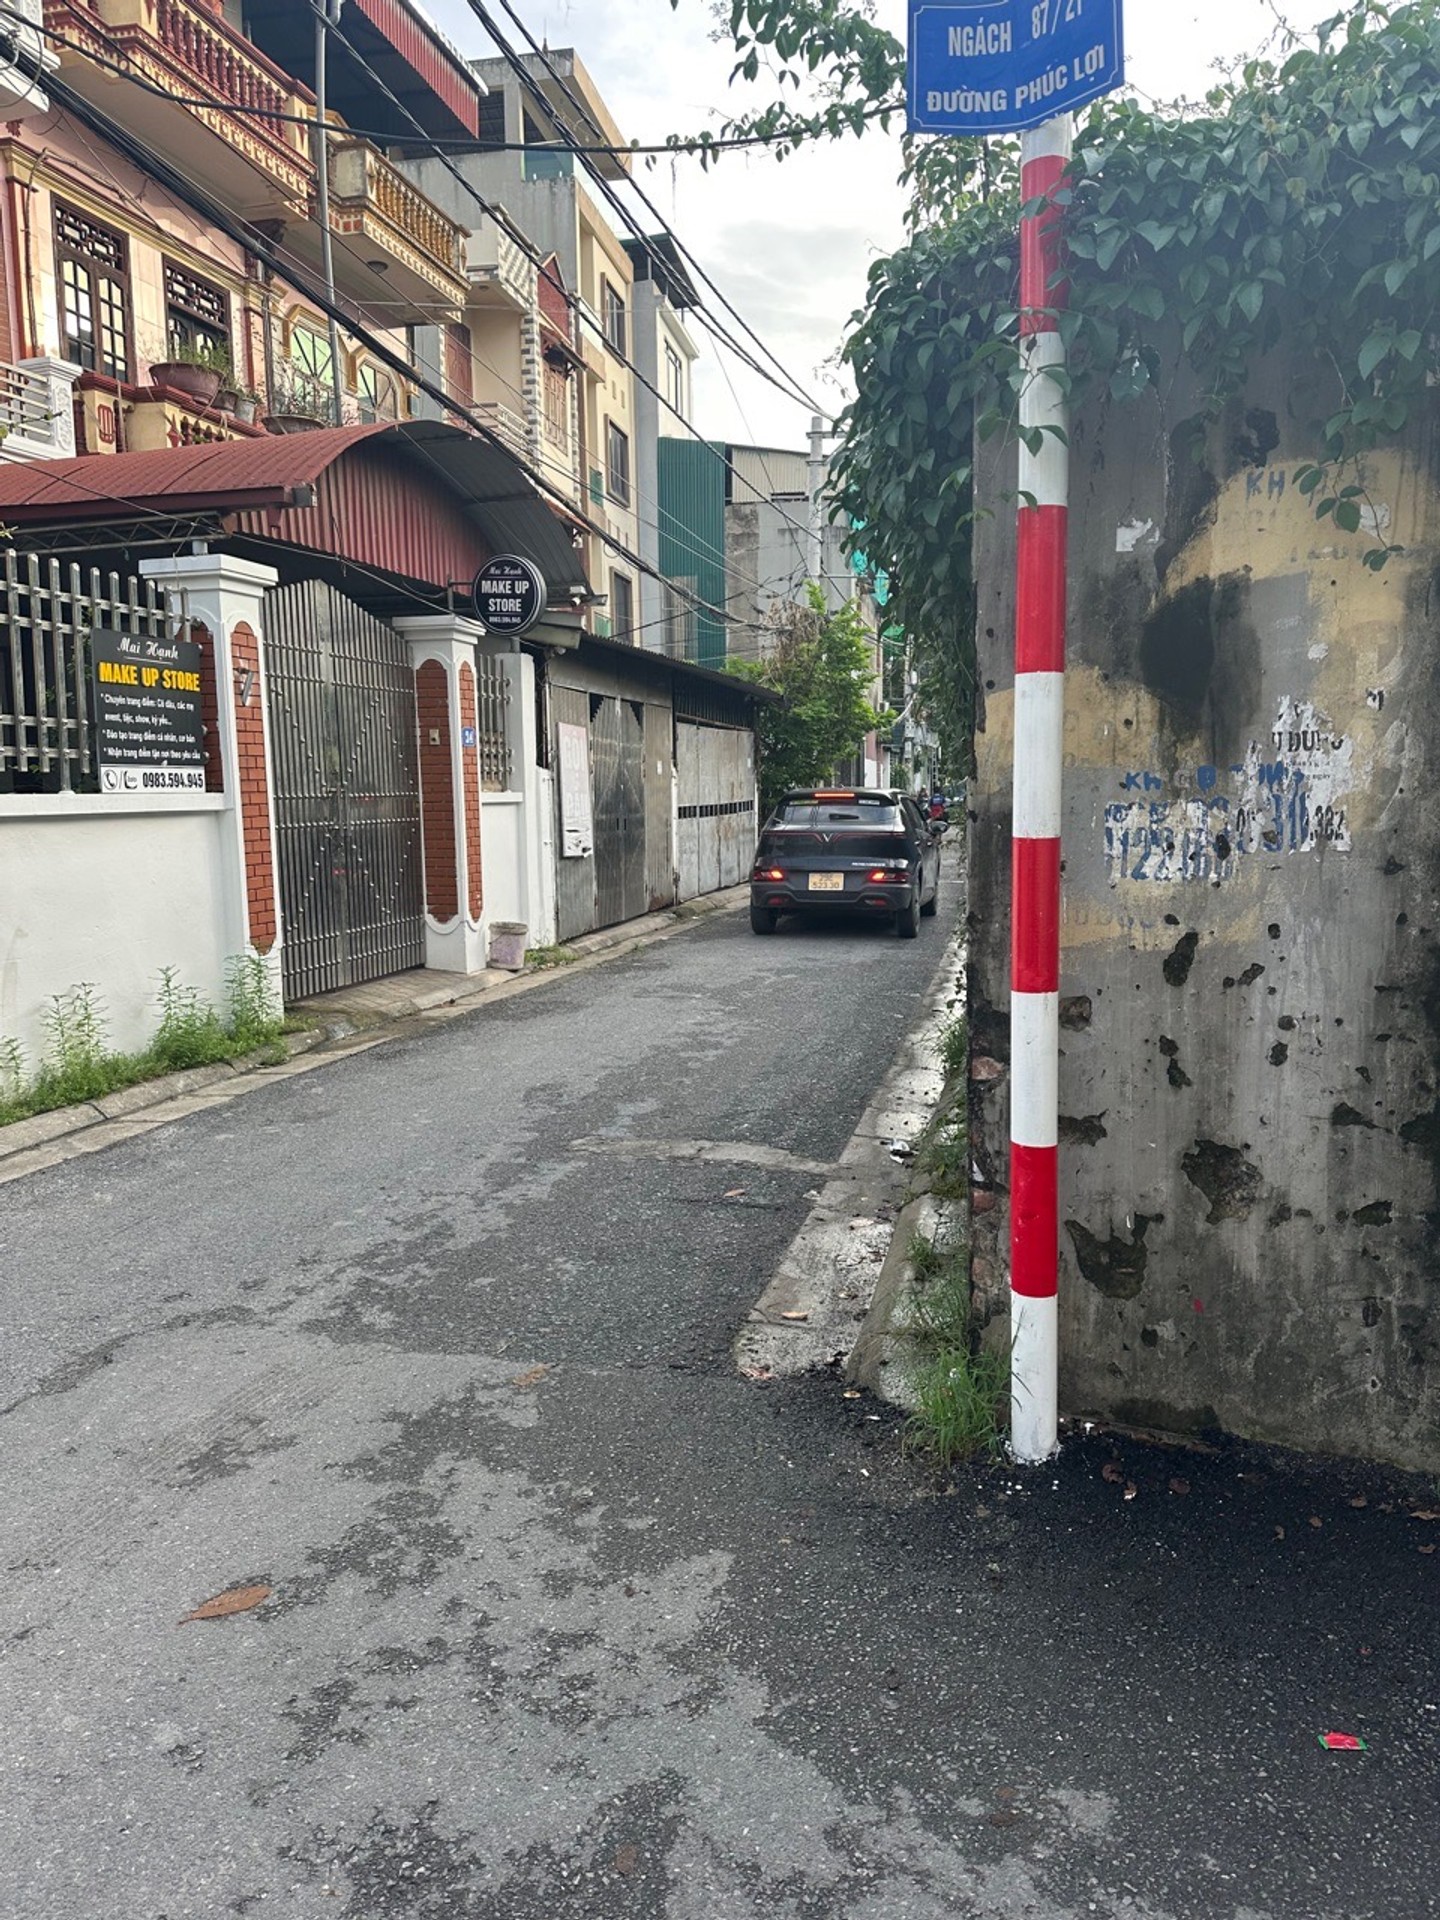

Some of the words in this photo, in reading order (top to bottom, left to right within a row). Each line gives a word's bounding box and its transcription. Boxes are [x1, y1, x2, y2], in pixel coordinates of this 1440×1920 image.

[948, 17, 1012, 57] NGÁCH
[926, 85, 1008, 113] ĐƯỜNG
[1015, 64, 1069, 110] PHÚC
[1073, 44, 1106, 82] LỢI
[481, 580, 512, 594] MAKE
[514, 580, 530, 594] UP
[488, 598, 522, 612] STORE
[117, 637, 140, 654] Mai
[146, 641, 179, 660] Hạnh
[98, 661, 138, 686] MAKE
[141, 667, 160, 687] UP
[162, 669, 201, 692] STORE
[142, 772, 204, 788] 0983.594.945
